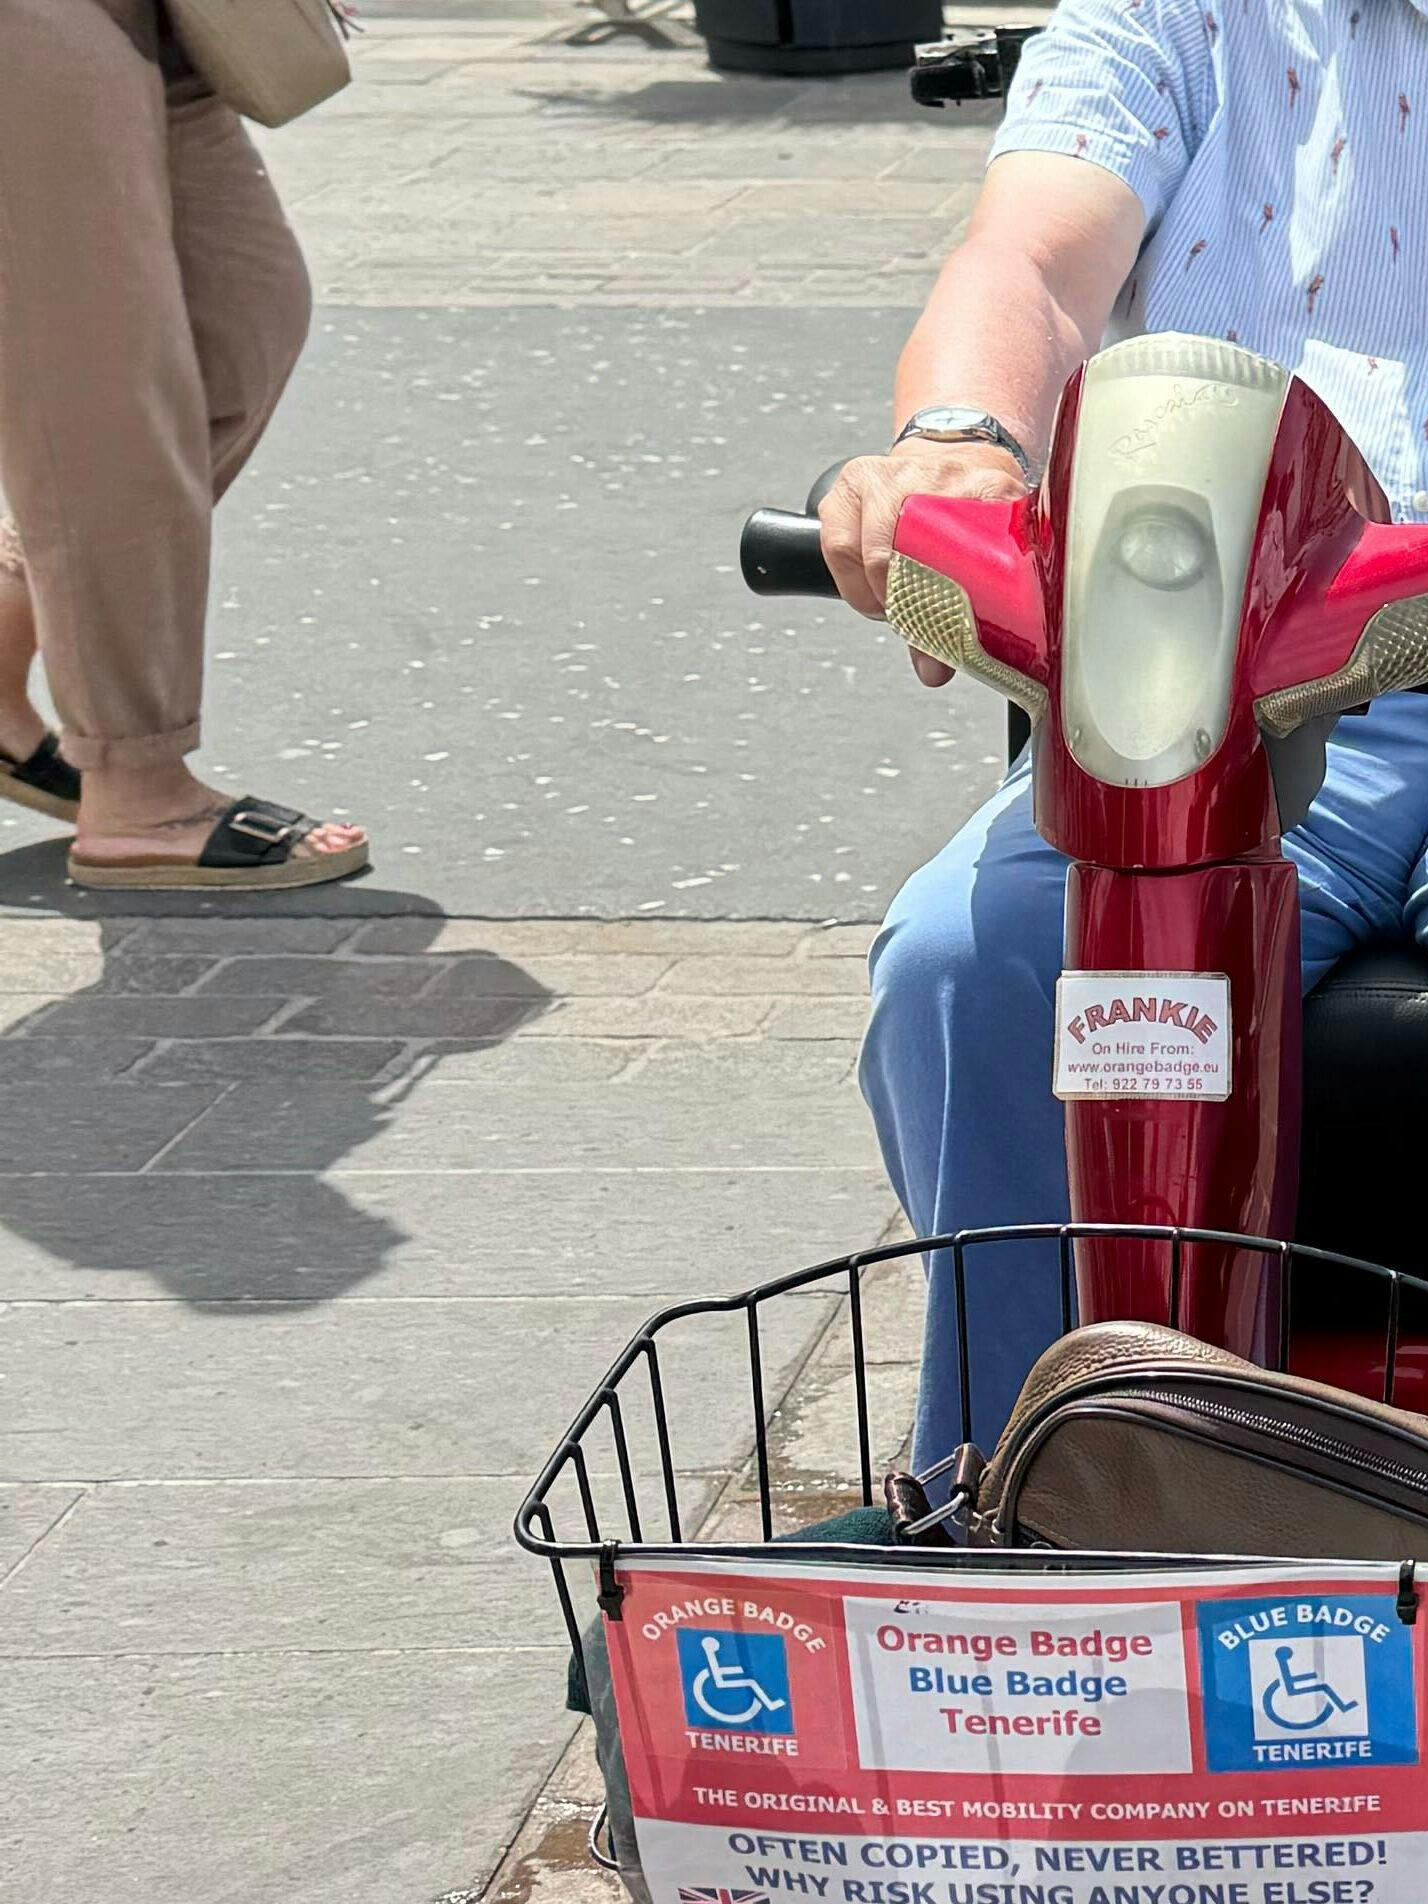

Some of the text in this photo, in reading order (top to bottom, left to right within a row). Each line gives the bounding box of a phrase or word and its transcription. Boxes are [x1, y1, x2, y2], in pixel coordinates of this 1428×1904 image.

[1067, 997, 1218, 1045] FRANKIE
[1092, 1042, 1194, 1055] On Hire From:
[1068, 1060, 1218, 1075] www.orangebadge.eu
[1084, 1078, 1203, 1091] Tel: 922 79 73 55
[641, 1598, 826, 1654] ORANGE BADGE
[876, 1624, 1153, 1662] Orange Badge
[1217, 1604, 1391, 1650] BLUE BADGE
[909, 1666, 1128, 1702] Blue Badge
[940, 1708, 1102, 1737] Tenerife
[685, 1731, 800, 1756] TENERIFE
[1252, 1740, 1373, 1763] TENERIFE
[692, 1787, 1381, 1821] THE ORIGINAL & BEST MOBILITY COMPANY ON TENERIFE
[727, 1833, 1388, 1877] OFTEN COPIED, NEVER BETTERED!
[744, 1864, 830, 1898] WHY
